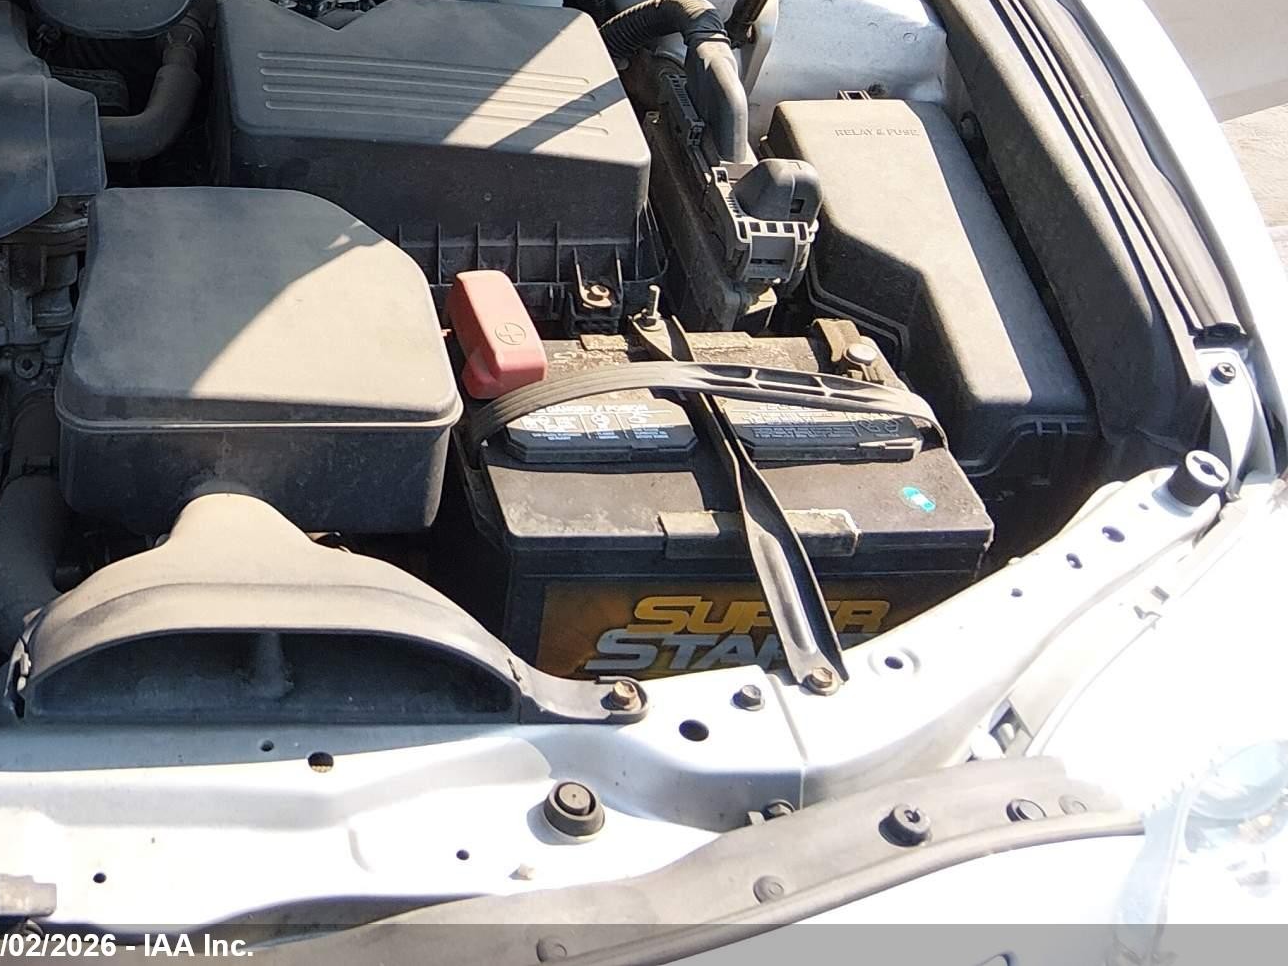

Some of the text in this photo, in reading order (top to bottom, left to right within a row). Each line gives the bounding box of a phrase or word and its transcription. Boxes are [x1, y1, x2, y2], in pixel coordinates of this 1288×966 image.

[834, 128, 873, 137] RELAY
[886, 128, 920, 137] FUSE
[626, 595, 890, 634] SUPR
